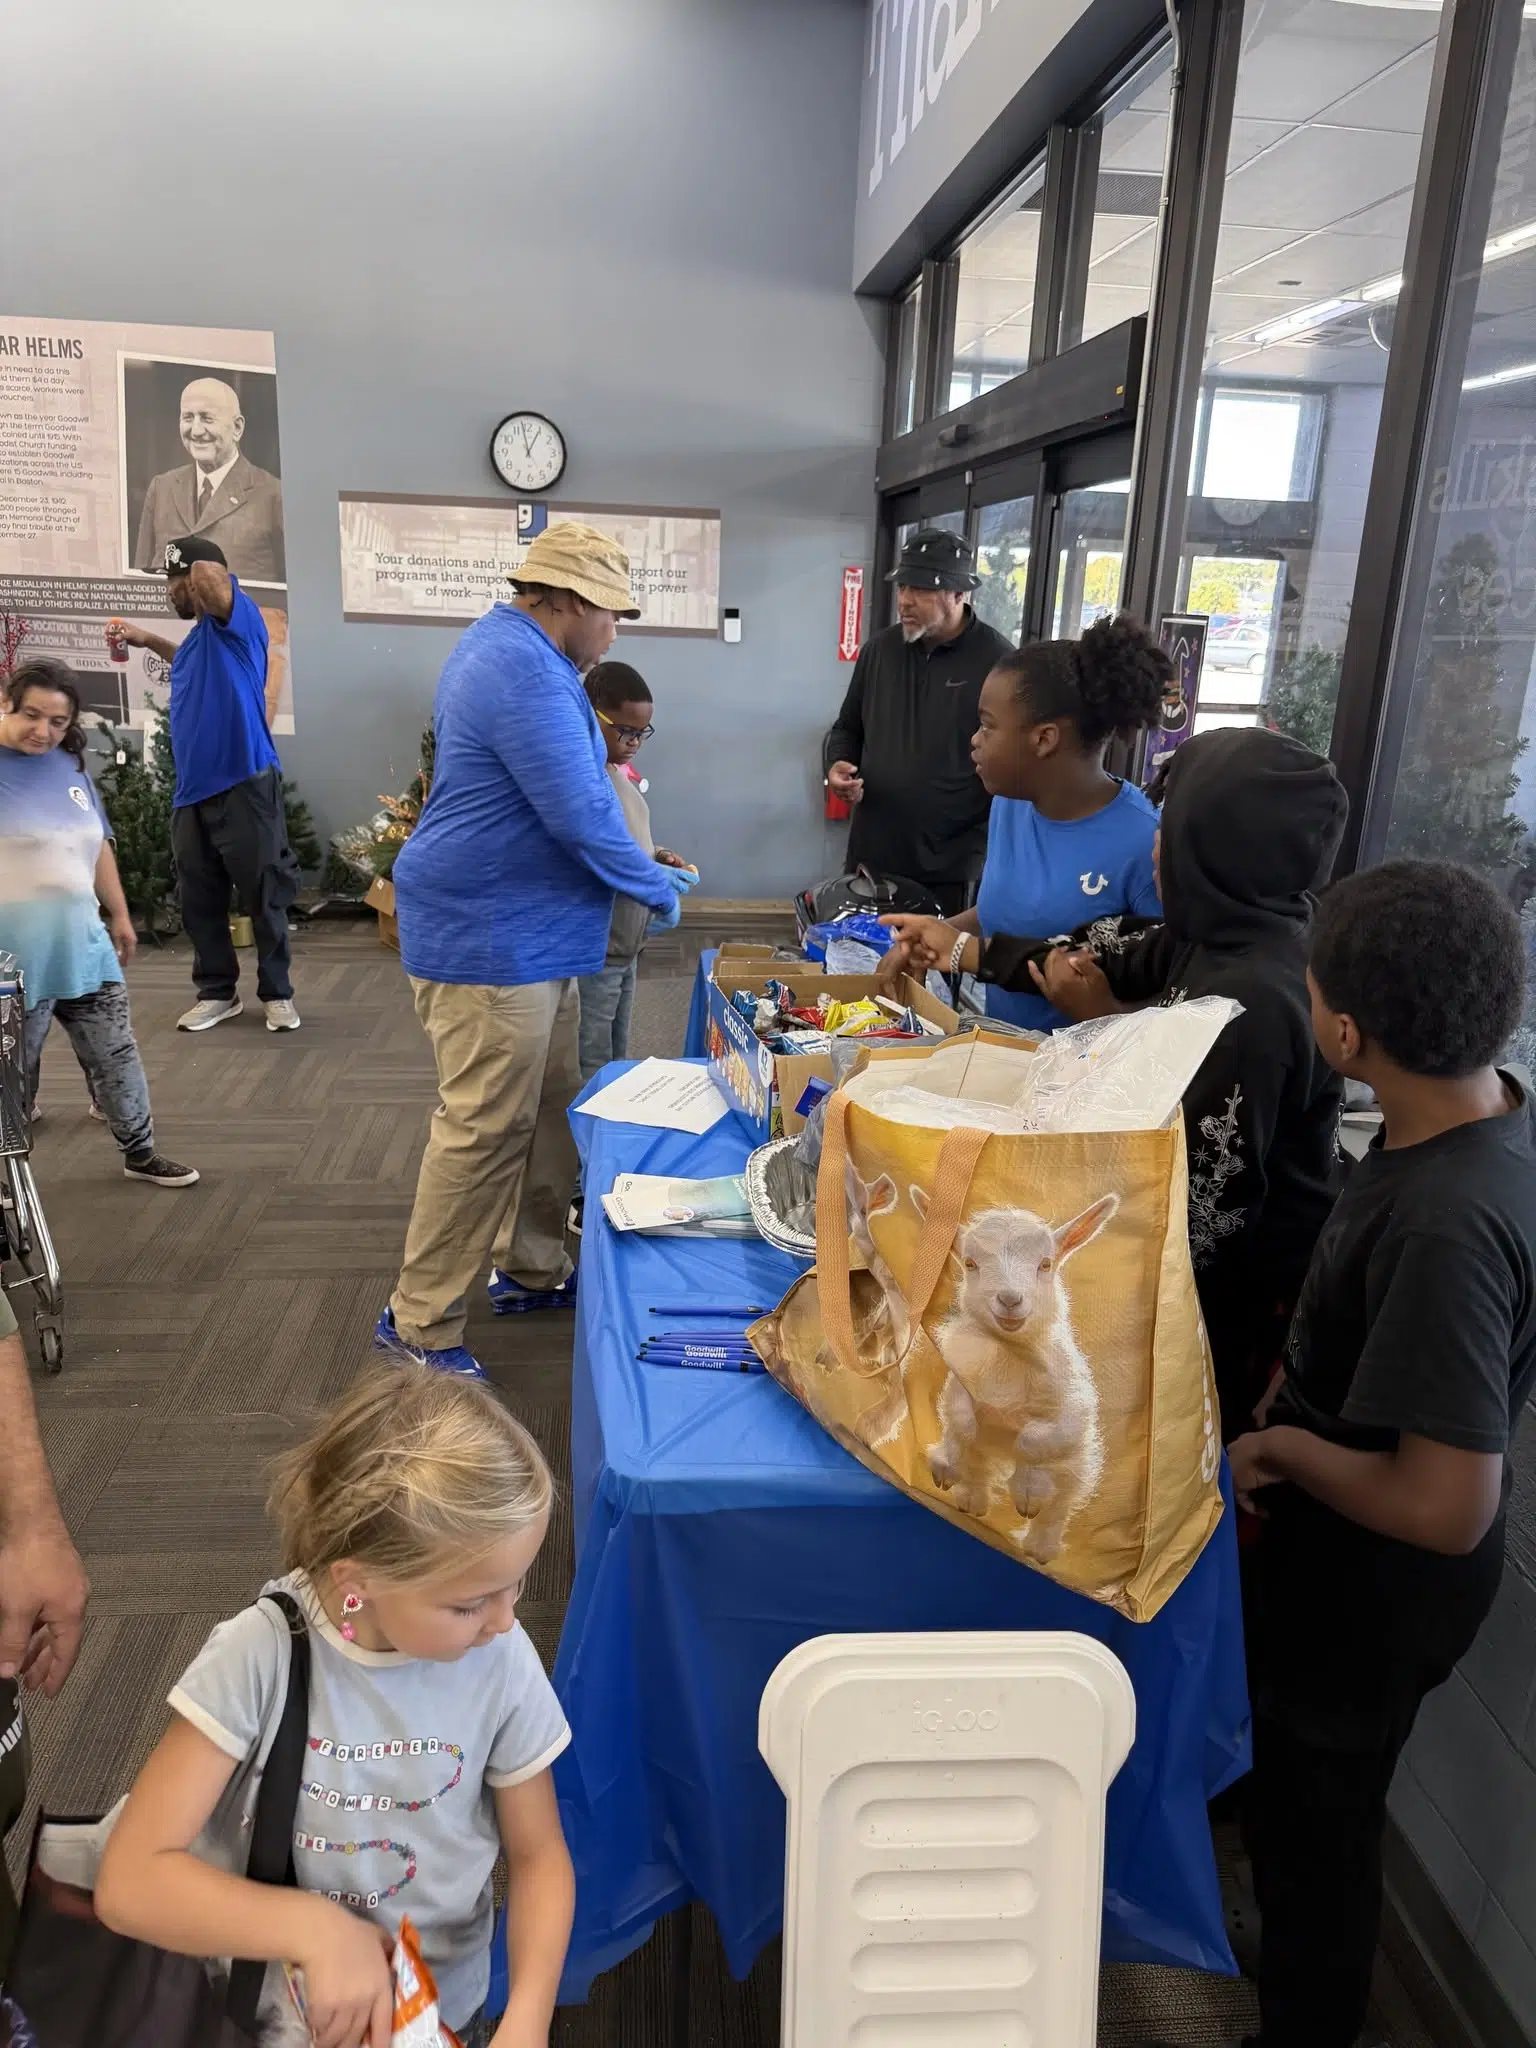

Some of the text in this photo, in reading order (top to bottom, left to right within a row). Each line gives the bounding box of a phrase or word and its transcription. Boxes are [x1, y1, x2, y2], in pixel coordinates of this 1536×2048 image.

[0, 335, 84, 359] AR HELMS
[44, 367, 55, 375] do
[9, 375, 31, 383] them
[33, 386, 63, 395] workers
[64, 388, 84, 396] were
[13, 413, 23, 421] as
[24, 412, 38, 421] the
[39, 414, 56, 424] year
[57, 414, 90, 424] Goodwill
[9, 422, 23, 430] the
[24, 422, 43, 431] term
[44, 423, 77, 432] Goodwill
[513, 425, 520, 436] 11
[2, 431, 28, 440] coined
[28, 432, 46, 440] until
[62, 433, 82, 441] With
[503, 434, 514, 445] 10
[546, 436, 553, 446] 2
[18, 440, 46, 449] Church
[8, 450, 42, 459] establish
[43, 451, 75, 460] Goodwill
[501, 448, 509, 457] 9
[550, 448, 557, 458] 3
[30, 460, 55, 469] across
[56, 461, 69, 469] the
[59, 469, 93, 480] including
[527, 473, 535, 482] 6
[15, 505, 41, 514] people
[42, 505, 77, 516] thronged
[9, 513, 44, 522] Memorial
[44, 514, 72, 523] Church
[72, 515, 81, 524] of
[12, 522, 29, 531] final
[29, 523, 54, 532] tribute
[55, 524, 63, 532] at
[64, 525, 76, 533] his
[375, 552, 688, 581] Your donations and purc pport our
[375, 569, 688, 596] programs that empow he power
[846, 575, 861, 585] FIRE
[12, 580, 53, 590] MEDALLION
[53, 581, 62, 590] IN
[90, 583, 115, 592] HONOR
[116, 584, 132, 593] WAS
[132, 585, 157, 594] ADDED
[157, 586, 167, 594] TO
[425, 585, 438, 597] of
[56, 591, 70, 600] THE
[70, 591, 90, 600] ONLY
[90, 592, 125, 602] NATIONAL
[126, 594, 167, 603] MONUMENT
[15, 599, 24, 608] TO
[25, 600, 44, 609] HELP
[45, 600, 73, 609] OTHERS
[74, 601, 102, 610] REALIZE
[103, 602, 109, 610] A
[110, 603, 136, 611] BETTER
[846, 587, 856, 654] EXTINGUISHER
[76, 658, 111, 668] BOOKS
[723, 1006, 749, 1053] classic
[681, 1359, 725, 1369] Goodwill
[911, 1696, 1001, 1747] igloo
[321, 1738, 439, 1760] FOREVER
[309, 1784, 392, 1810] MOM'S
[329, 1891, 378, 1907] OXO
